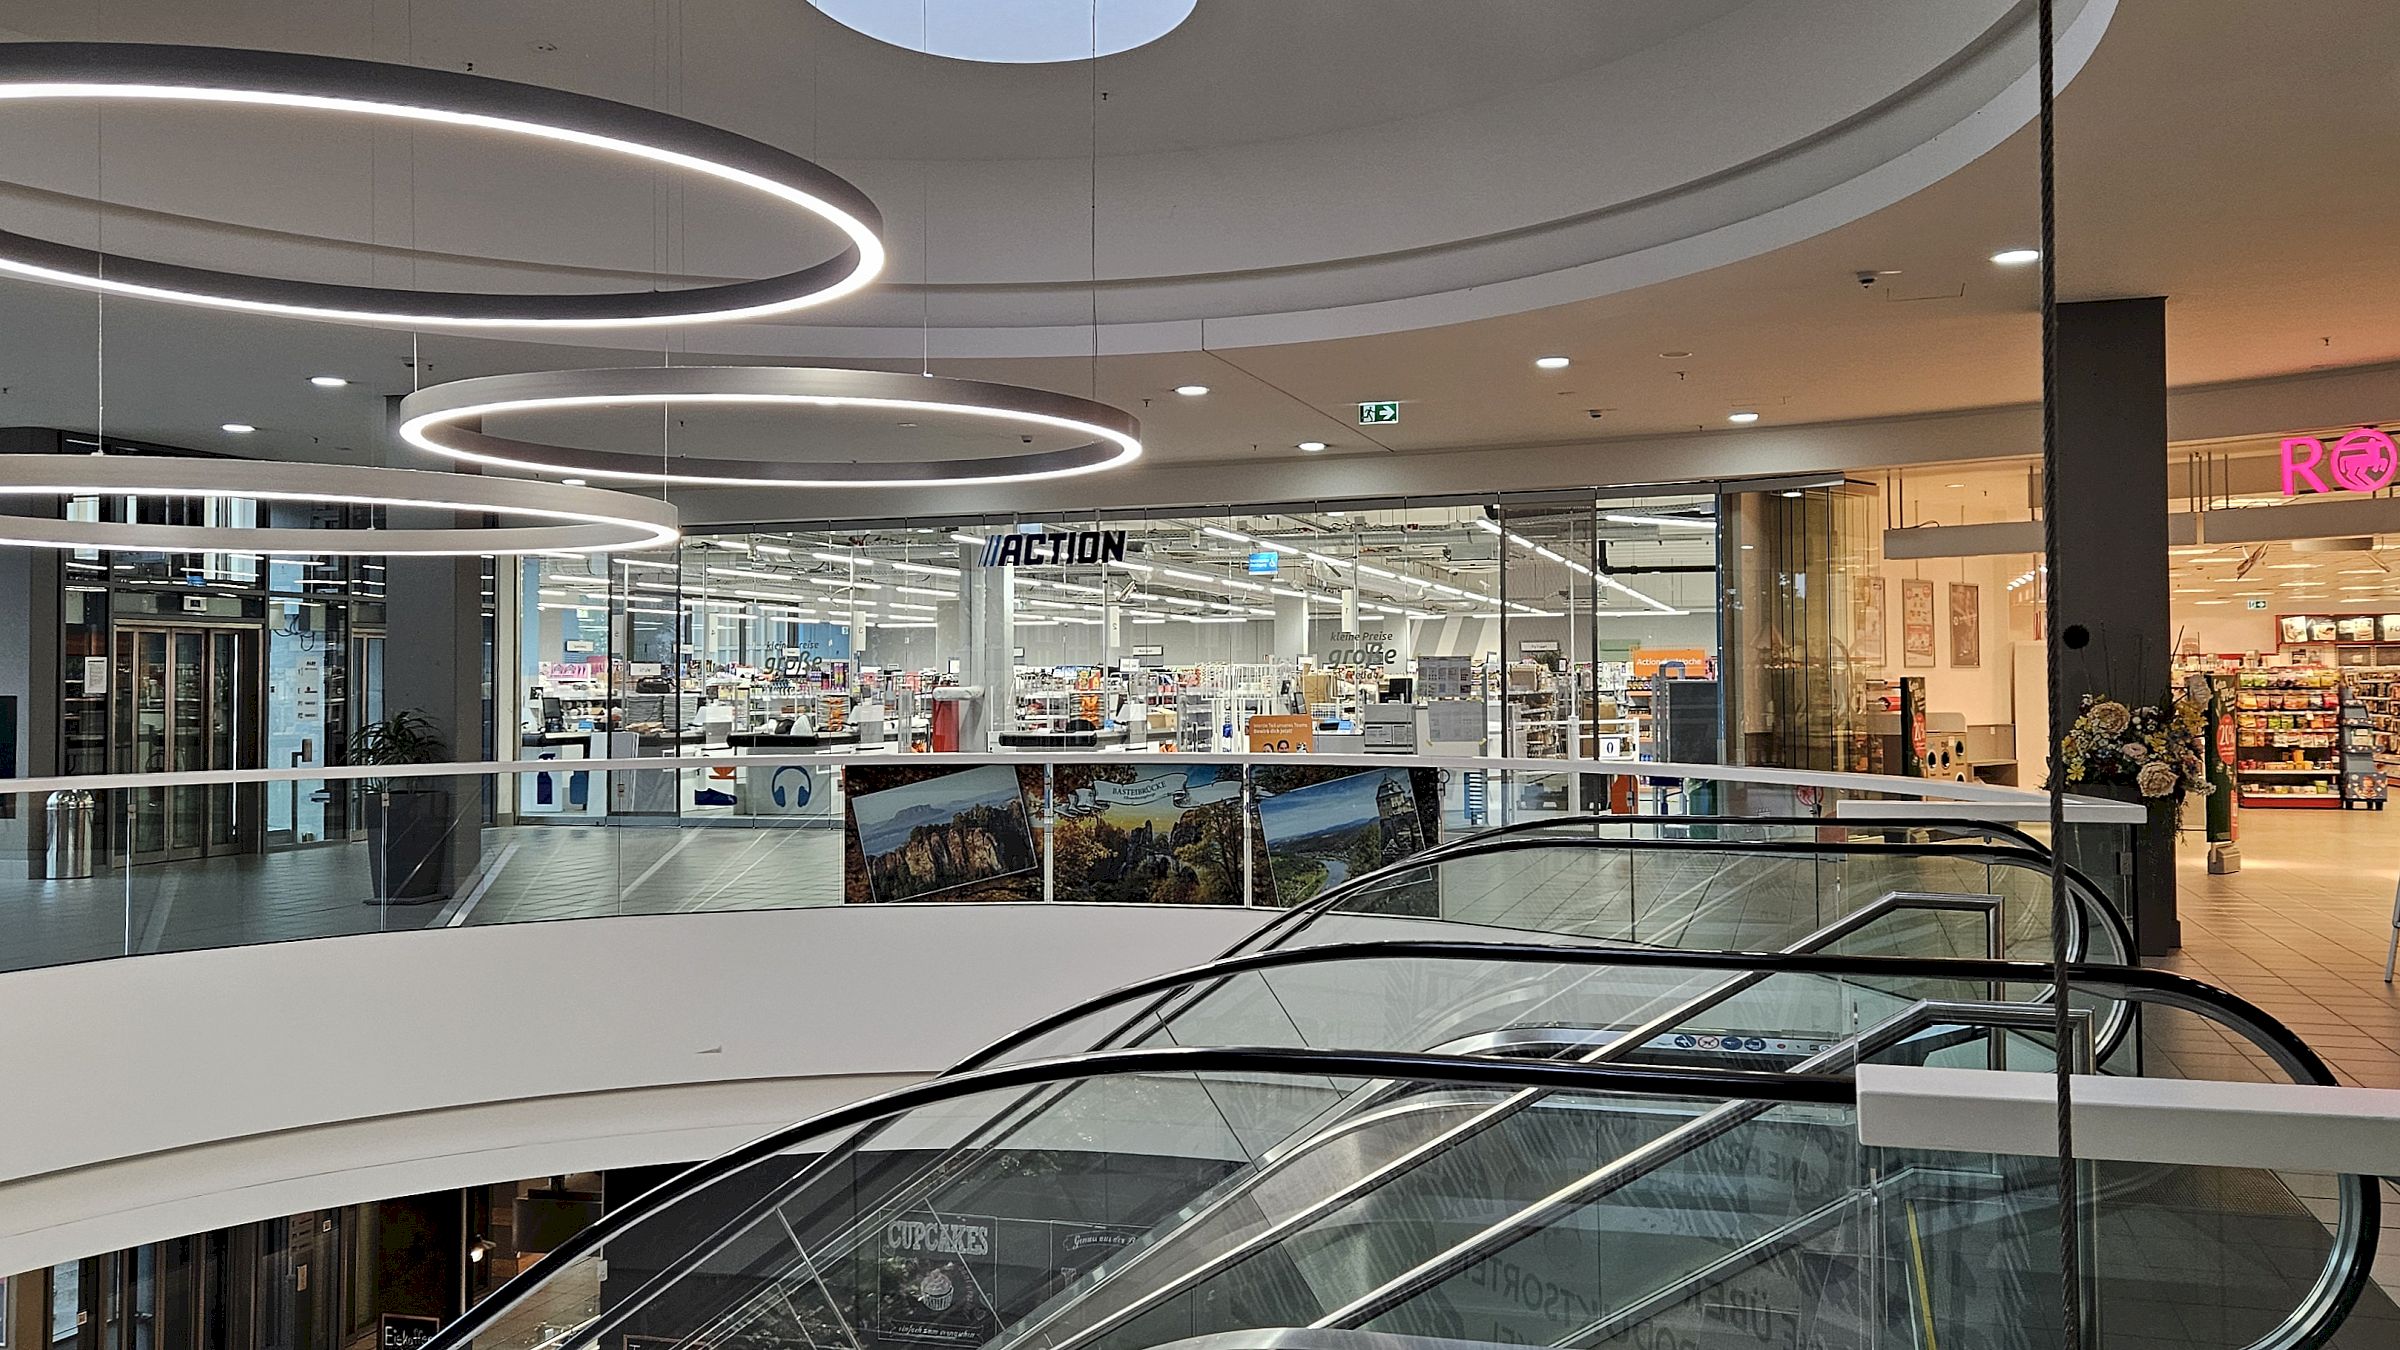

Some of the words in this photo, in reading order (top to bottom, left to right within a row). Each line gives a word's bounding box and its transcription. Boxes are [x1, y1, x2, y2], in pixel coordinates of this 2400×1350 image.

[998, 531, 1127, 567] ACTION
[1330, 631, 1360, 642] kleine
[1362, 631, 1394, 641] Preise
[887, 1220, 989, 1256] CUPCAKES
